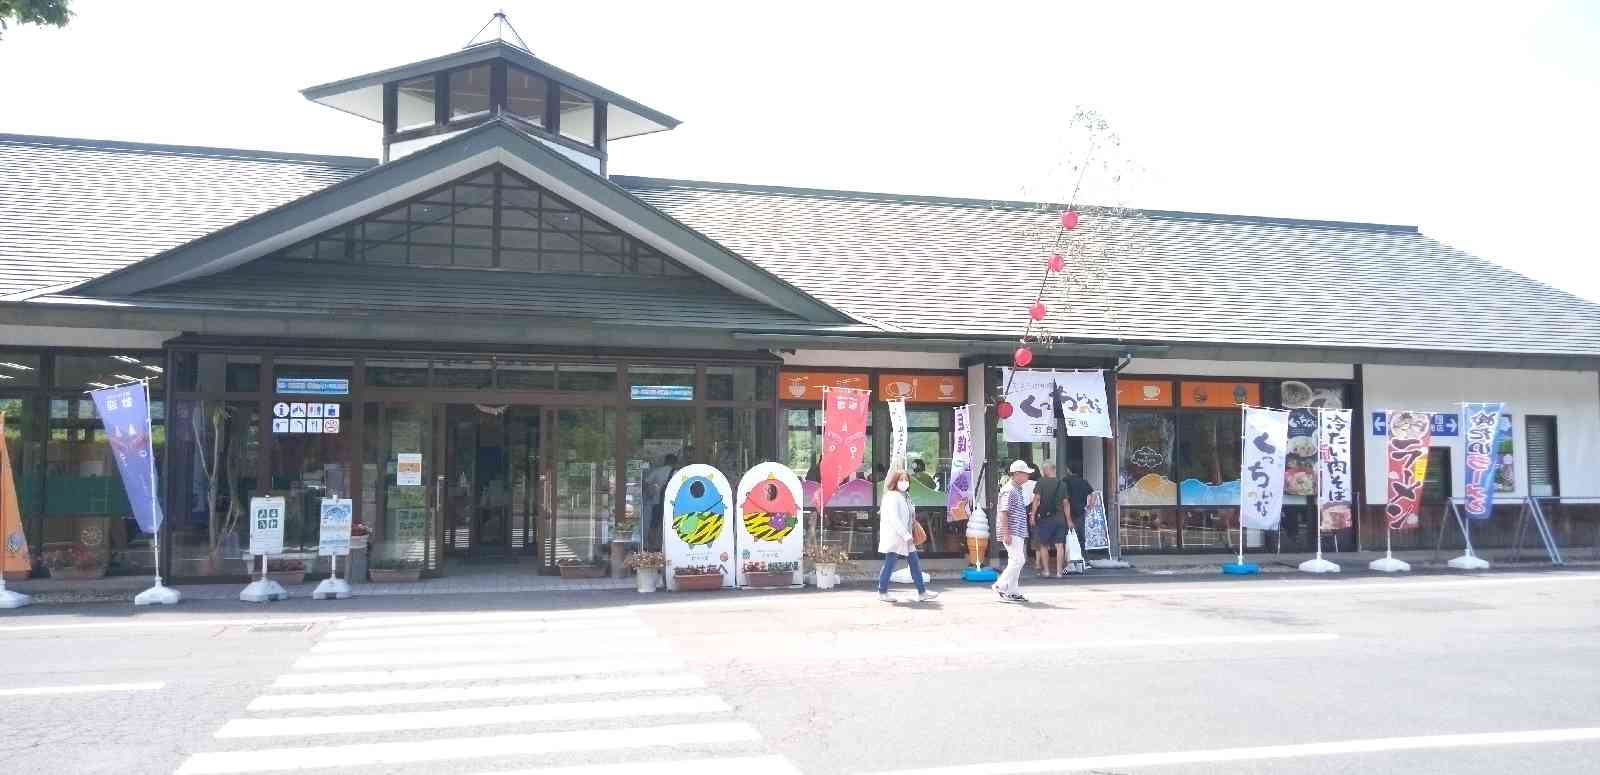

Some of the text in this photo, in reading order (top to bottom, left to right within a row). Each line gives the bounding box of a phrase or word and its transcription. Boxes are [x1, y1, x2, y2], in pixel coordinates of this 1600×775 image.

[1326, 414, 1347, 502] 冷たい肉そば
[1384, 437, 1427, 530] ラーメン
